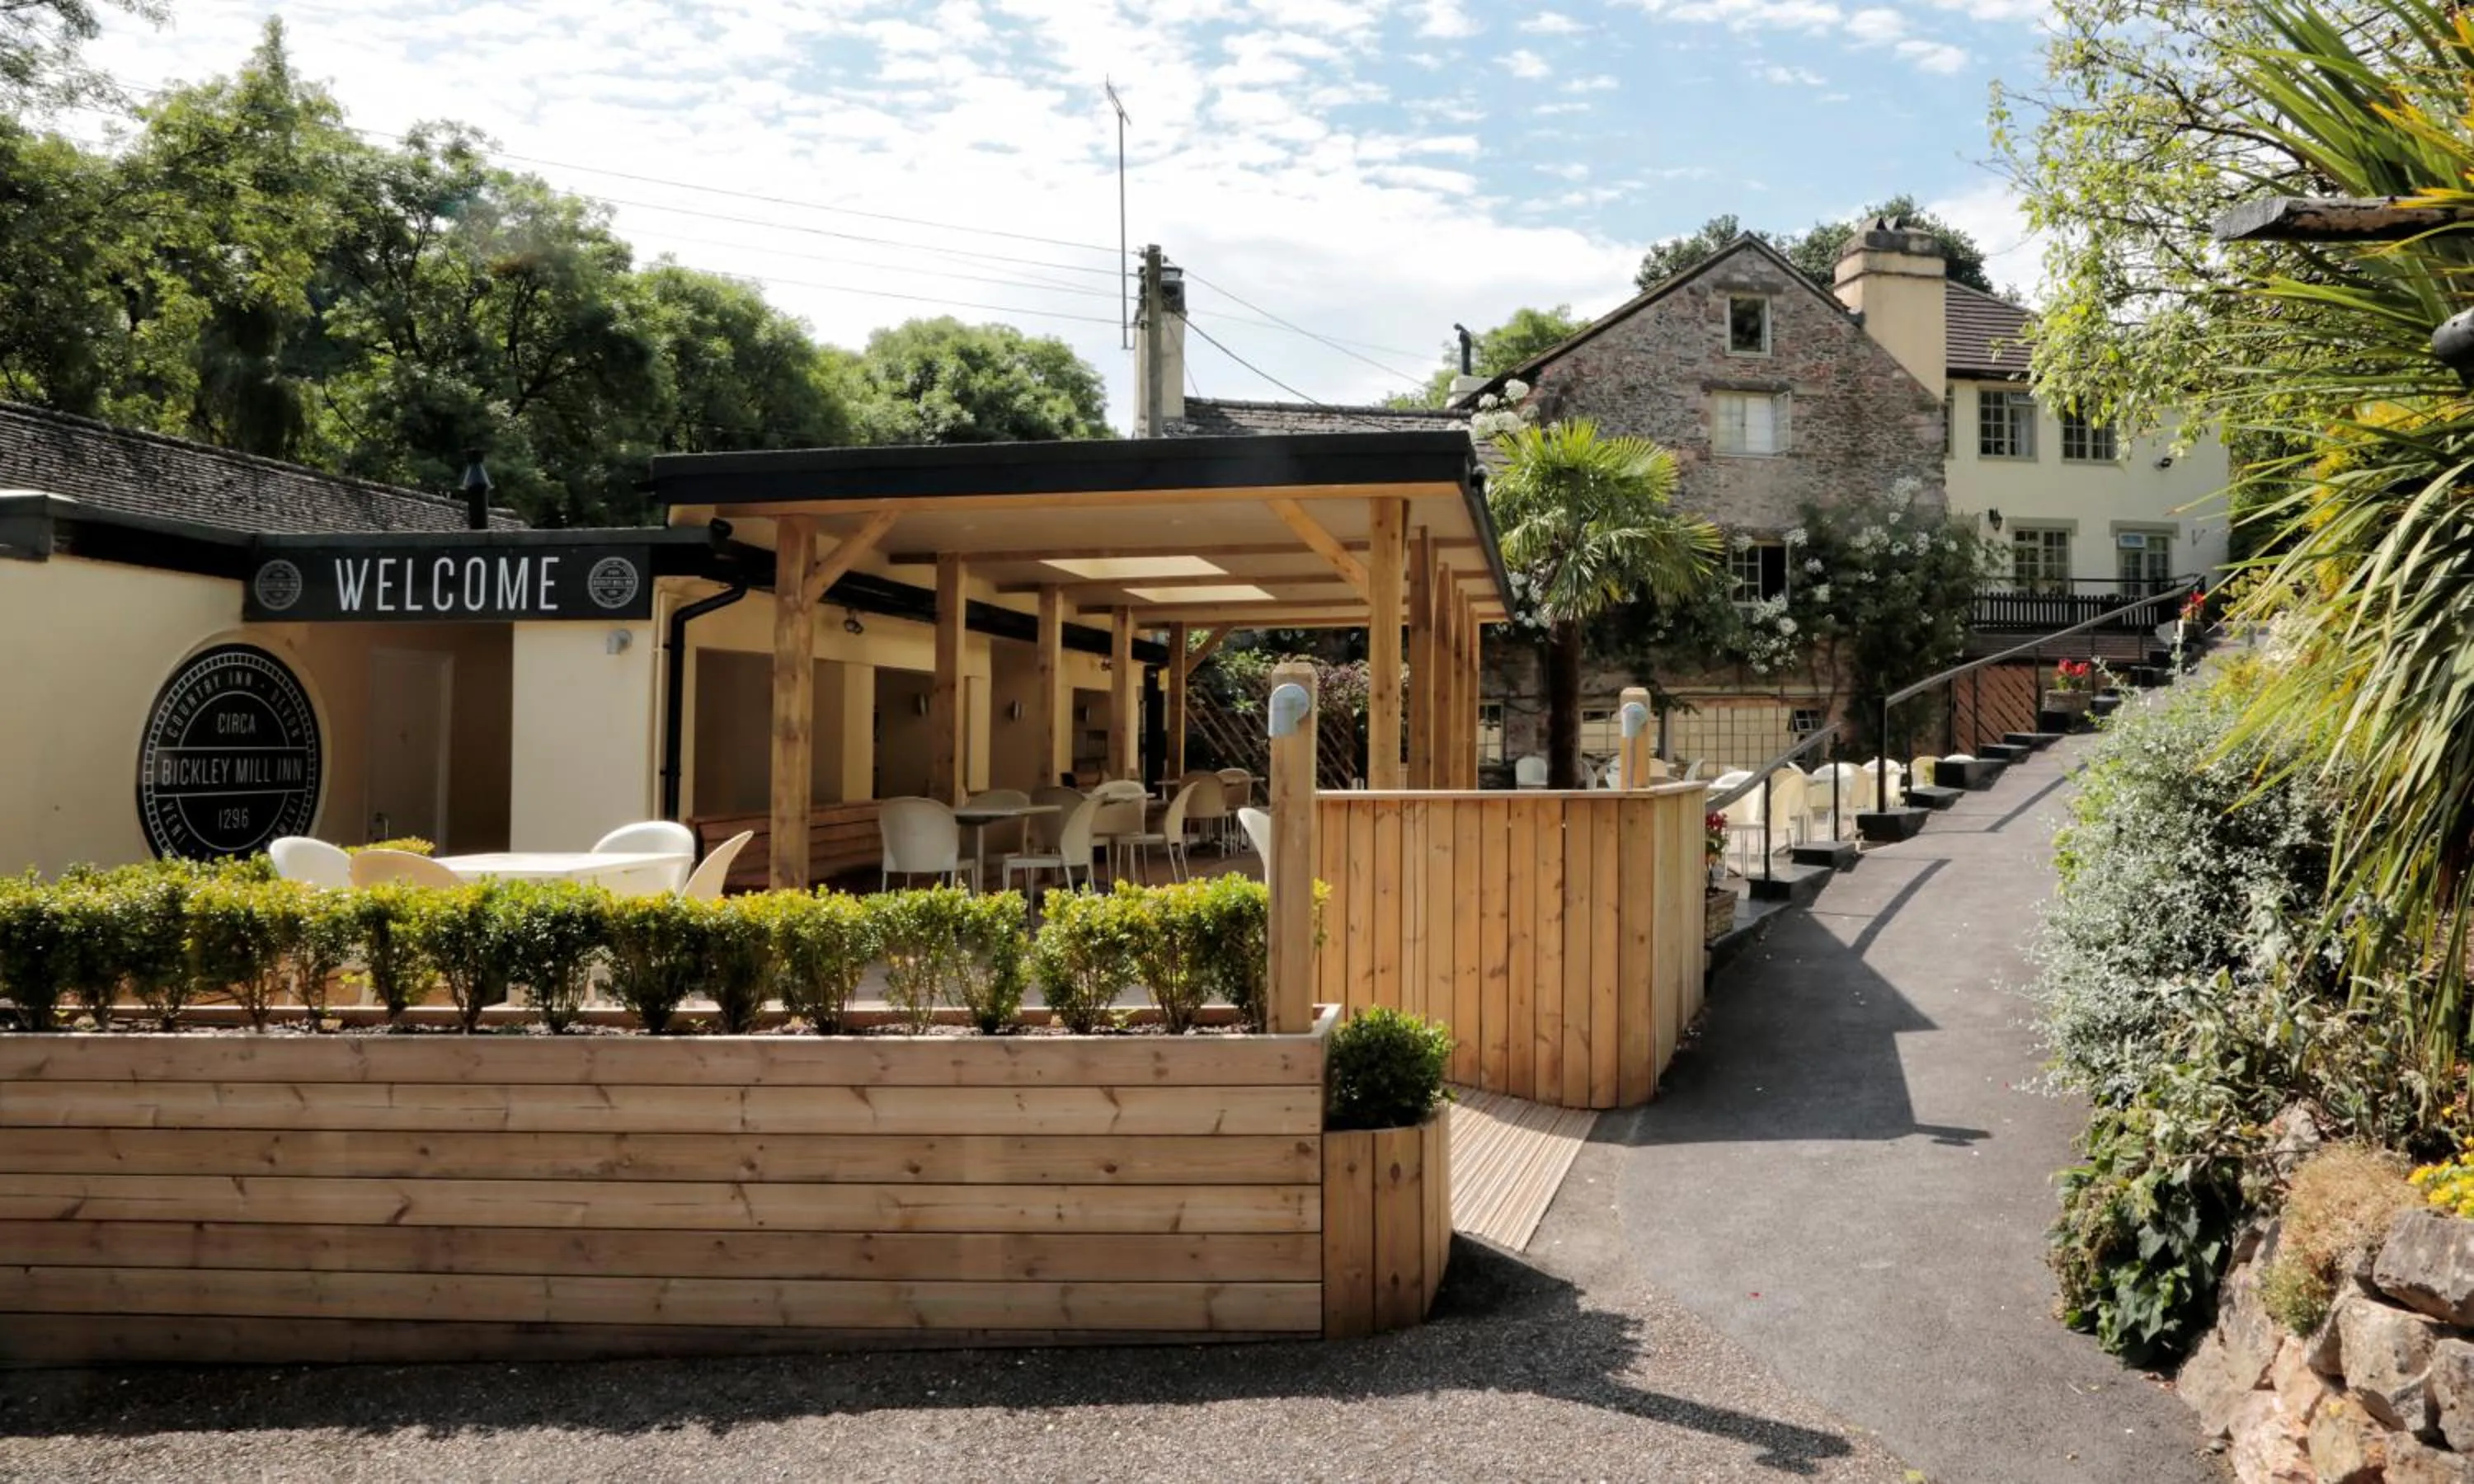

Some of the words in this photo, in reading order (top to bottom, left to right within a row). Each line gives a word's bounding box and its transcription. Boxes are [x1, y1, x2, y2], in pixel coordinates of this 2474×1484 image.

[335, 556, 560, 611] WELCOME
[166, 674, 221, 739] COUNTRY
[228, 670, 254, 687] INN
[270, 688, 300, 739] DEVON
[217, 712, 256, 735] CIRCA
[161, 758, 230, 787] BICKLEY
[235, 758, 271, 784] MILL
[276, 758, 303, 782] INN
[218, 808, 249, 831] 1296
